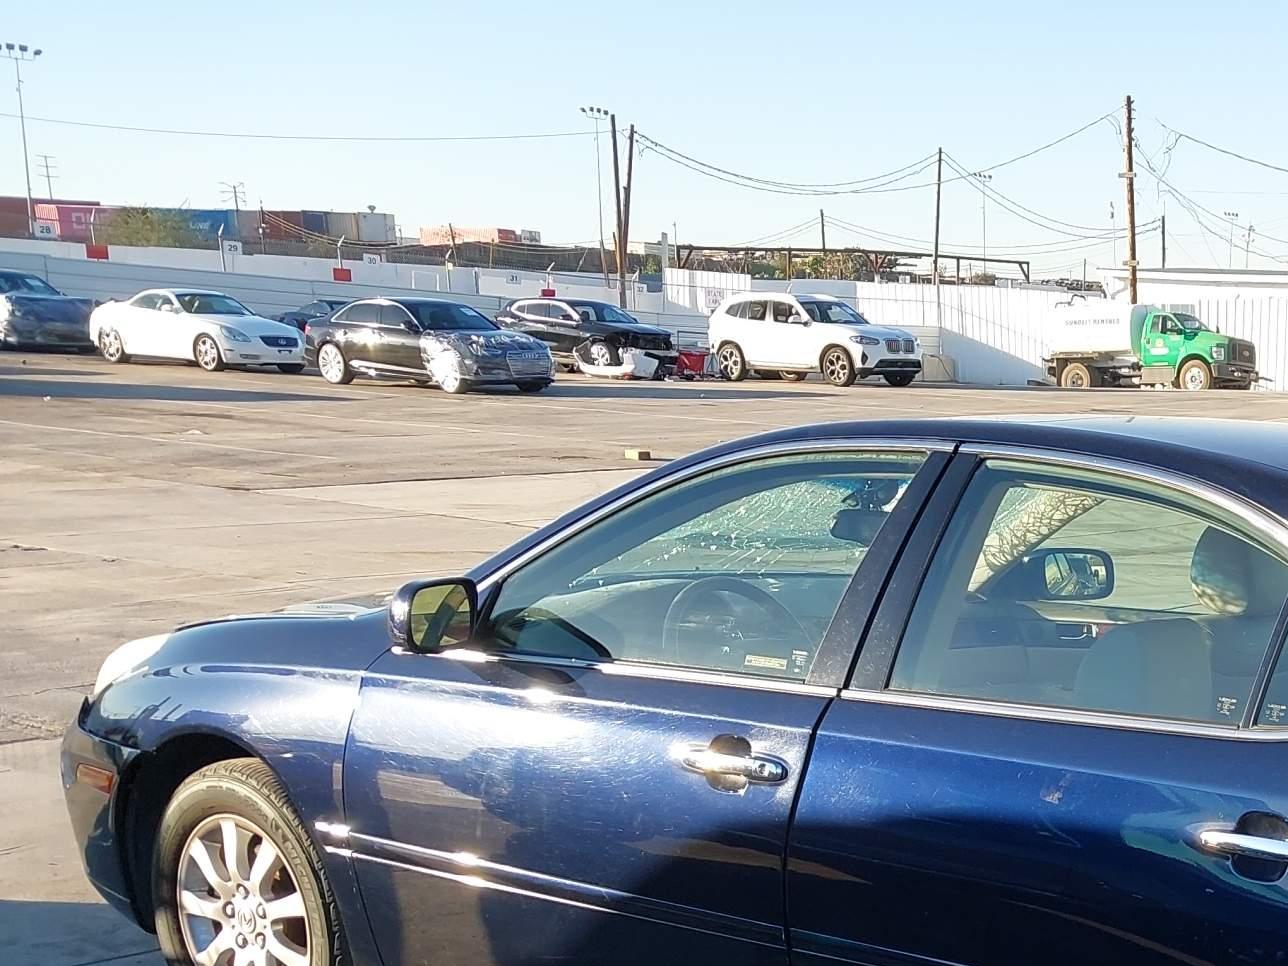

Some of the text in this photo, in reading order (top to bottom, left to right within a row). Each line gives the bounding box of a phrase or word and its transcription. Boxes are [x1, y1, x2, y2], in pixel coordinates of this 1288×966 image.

[39, 225, 52, 234] 28
[228, 244, 238, 252] 29
[367, 256, 377, 265] 30
